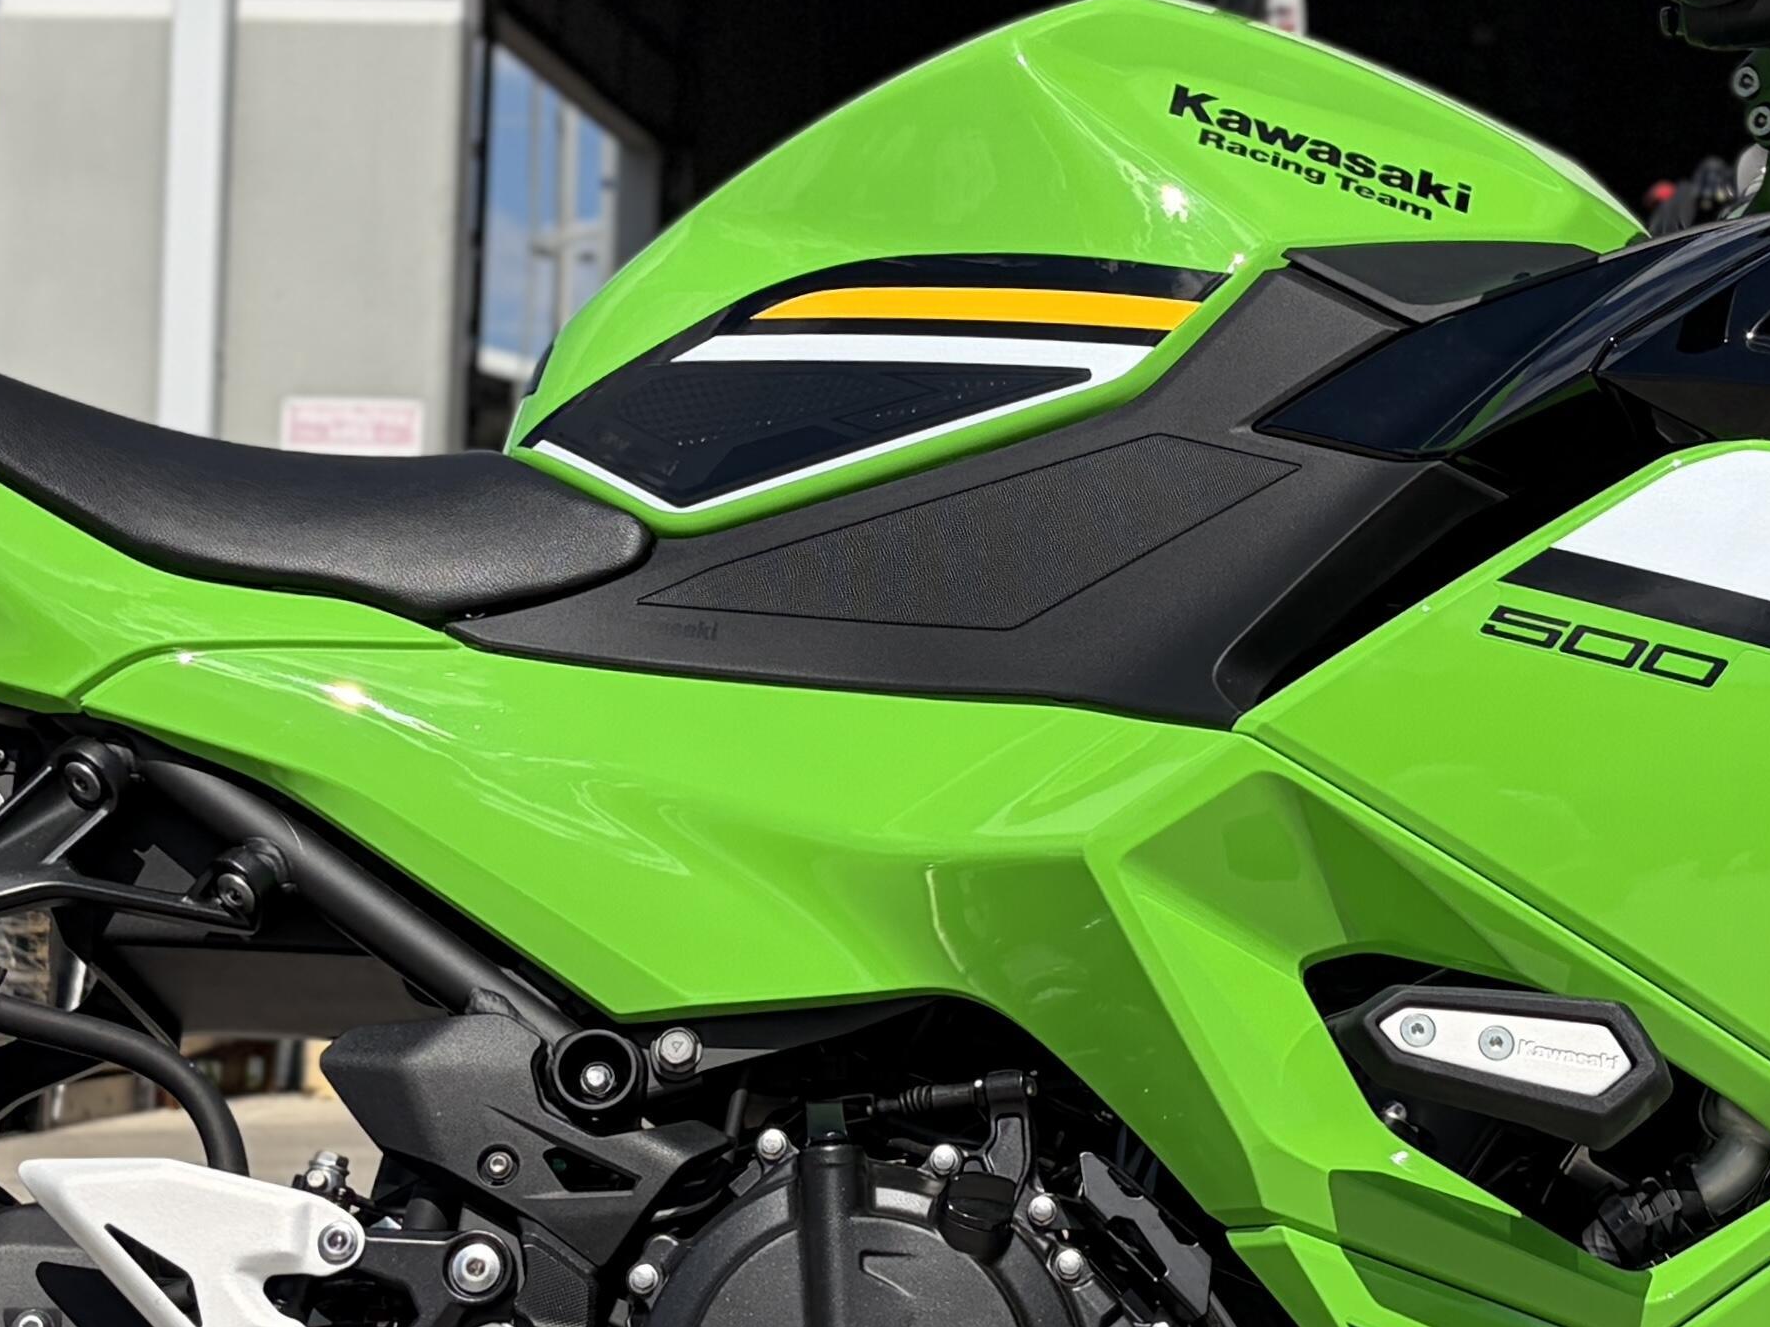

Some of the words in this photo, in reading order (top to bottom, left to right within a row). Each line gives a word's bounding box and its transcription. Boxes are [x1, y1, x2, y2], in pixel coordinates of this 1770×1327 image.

[1169, 84, 1472, 214] Kawasaki
[1198, 128, 1326, 185] Racing
[1335, 172, 1433, 220] Team
[1480, 605, 1728, 688] 500
